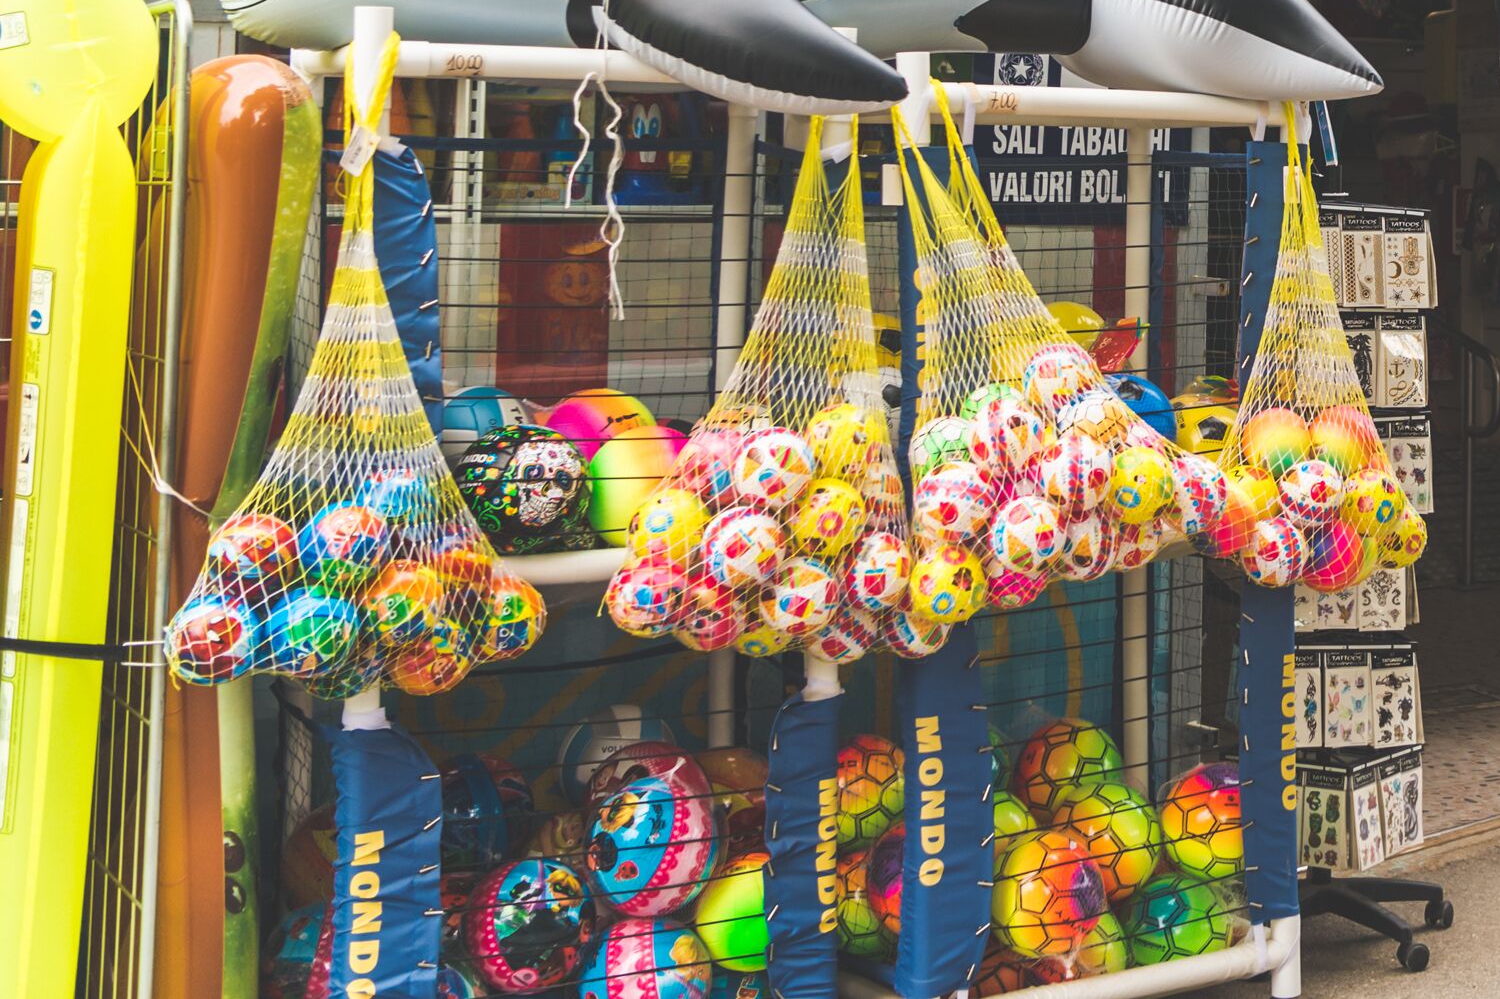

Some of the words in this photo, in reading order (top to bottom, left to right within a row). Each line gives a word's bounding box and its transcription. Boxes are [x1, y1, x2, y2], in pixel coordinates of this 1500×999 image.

[989, 170, 1073, 203] VALORI
[992, 125, 1045, 155] SALI
[815, 777, 839, 933] MONDO
[915, 715, 946, 887] MONDO
[345, 830, 384, 999] MONDO
